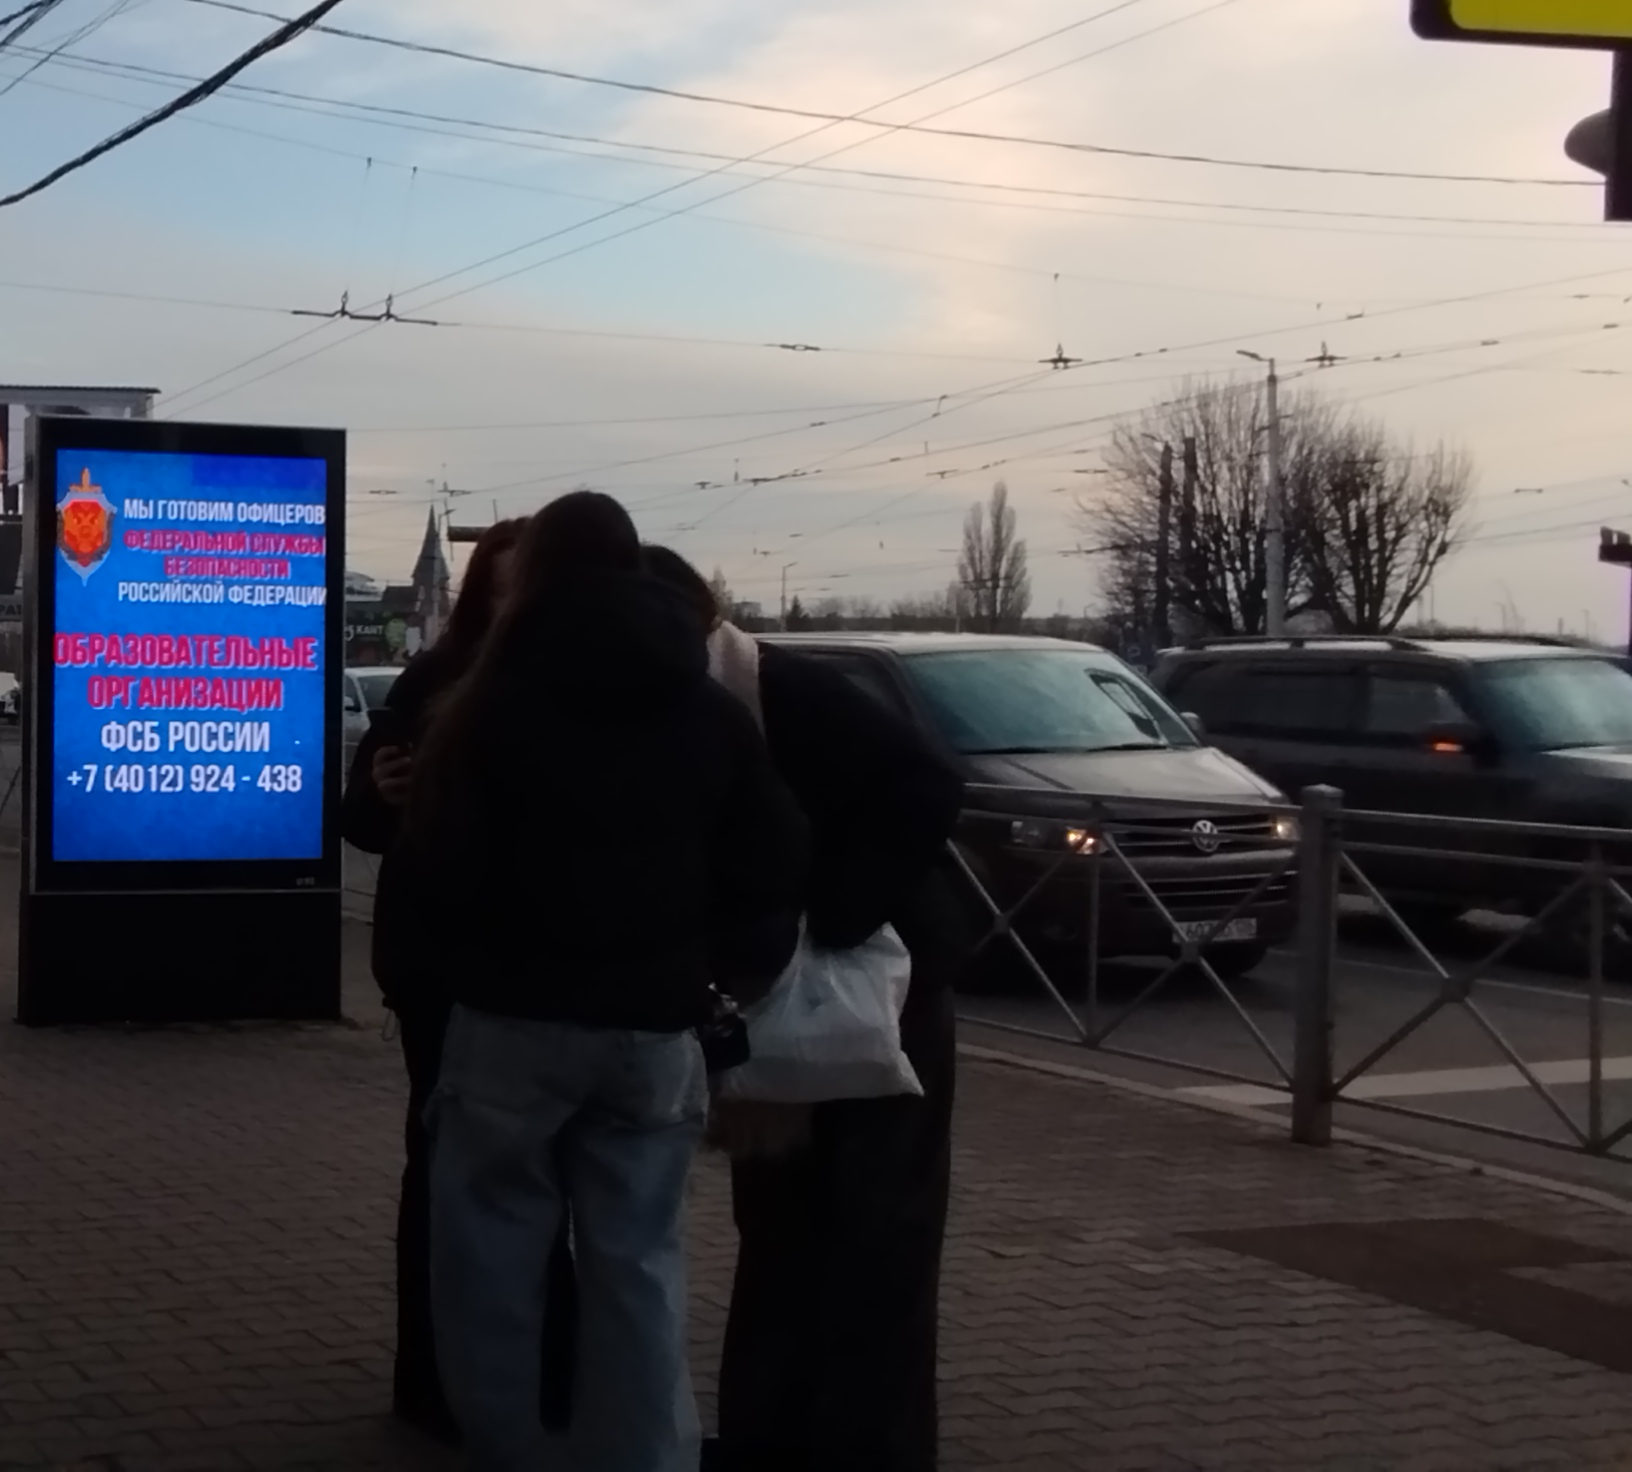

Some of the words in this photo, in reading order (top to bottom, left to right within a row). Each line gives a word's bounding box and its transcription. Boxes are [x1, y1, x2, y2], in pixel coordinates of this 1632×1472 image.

[124, 498, 153, 519] МЫ
[158, 500, 233, 522] ГОТОВИМ
[237, 502, 326, 525] ОФИЦЕРОВ
[123, 529, 250, 555] ФЕДЕРАЛЬНОЙ
[251, 532, 326, 557] СЛУЖБЫ
[164, 556, 291, 579] БЕЗОПАСНОСТИ
[118, 580, 225, 603] РОССИЙСКОЙ
[228, 585, 326, 607] ФЕДЕРАЦИИ
[53, 632, 318, 671] ОБРАЗОВАТЕЛЬНЫЕ
[87, 676, 284, 715] ОРГАНИЗАЦИИ
[101, 720, 160, 752] ФСБ
[168, 721, 270, 752] РОССИИ
[67, 764, 98, 792] +7
[105, 764, 184, 793] (4012)
[190, 765, 235, 792] 924
[257, 765, 302, 793] 438
